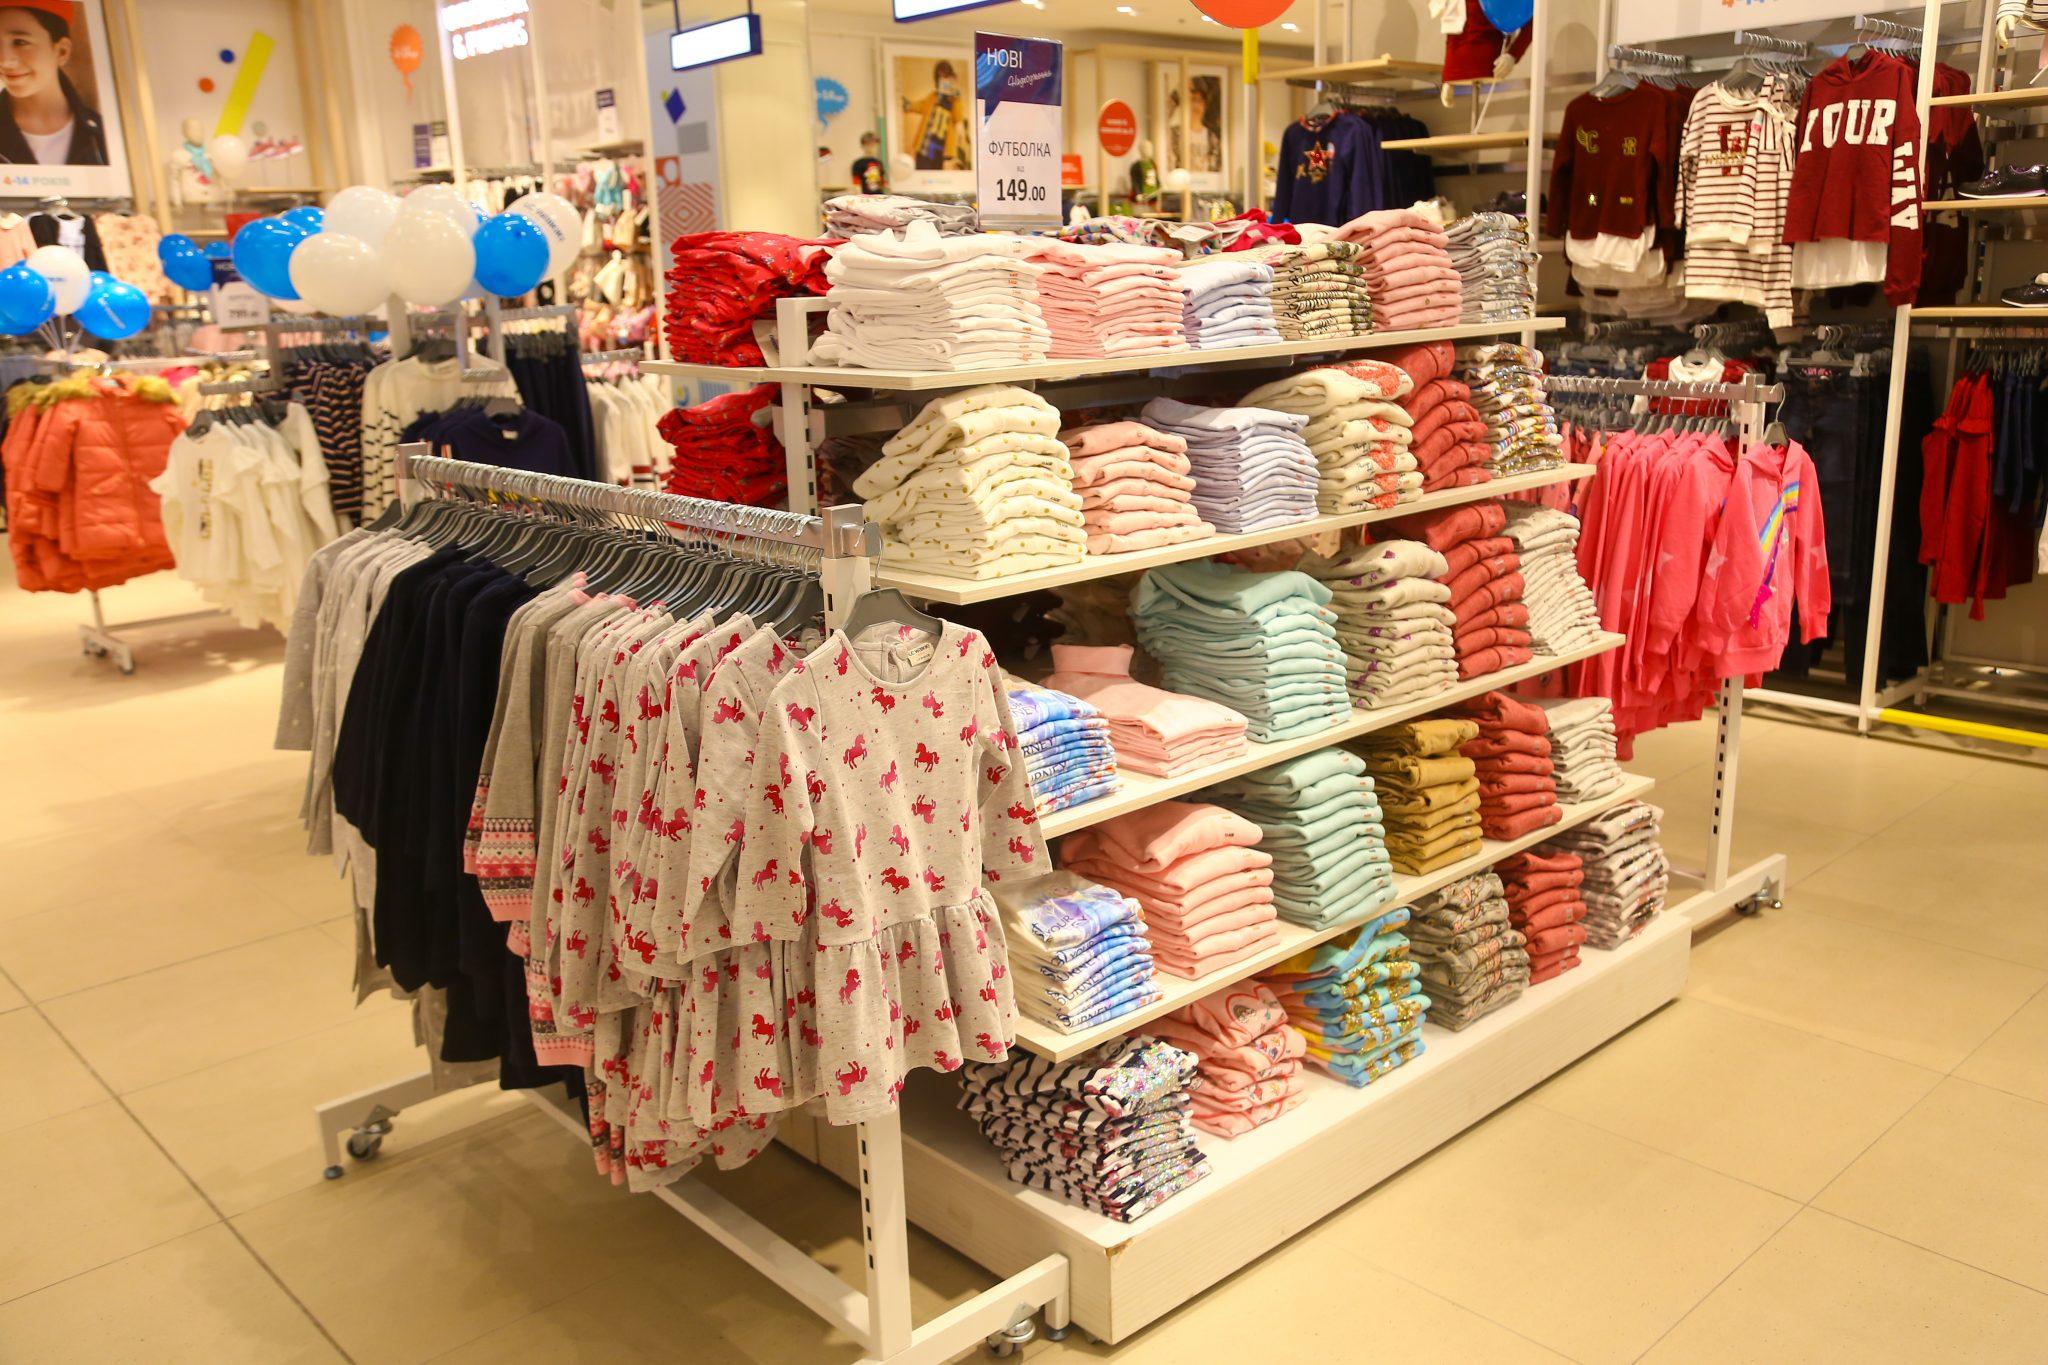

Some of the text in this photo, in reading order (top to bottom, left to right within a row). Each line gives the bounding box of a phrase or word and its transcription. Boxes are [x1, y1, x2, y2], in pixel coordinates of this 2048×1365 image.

[986, 47, 1023, 69] НОВІ
[988, 140, 1051, 157] ФУТБОЛКА
[996, 178, 1046, 202] 149.00
